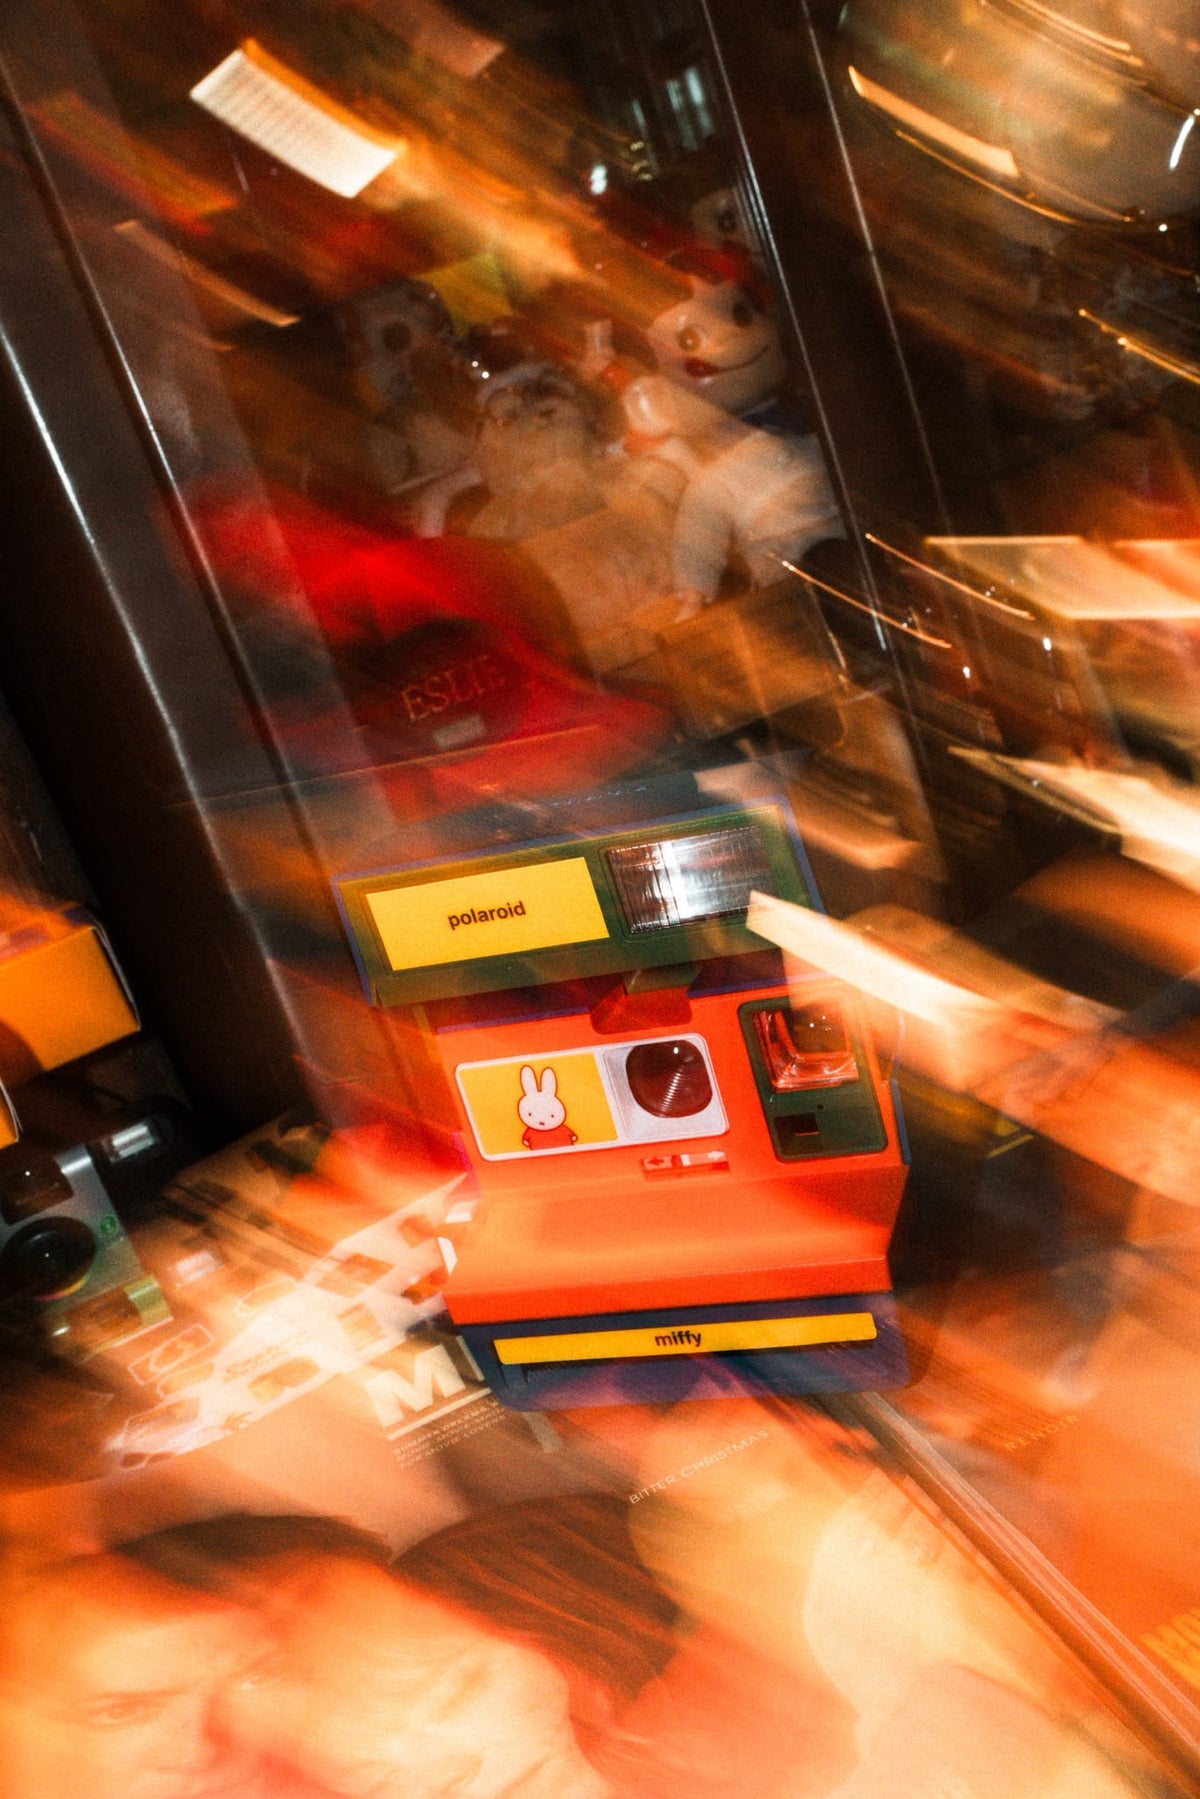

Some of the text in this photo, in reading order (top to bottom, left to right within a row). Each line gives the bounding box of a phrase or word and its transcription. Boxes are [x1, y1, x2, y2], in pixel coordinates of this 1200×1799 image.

[447, 900, 527, 931] polaroid
[654, 1330, 702, 1348] miffy
[629, 1429, 769, 1505] BITTER CHRISTMAS
